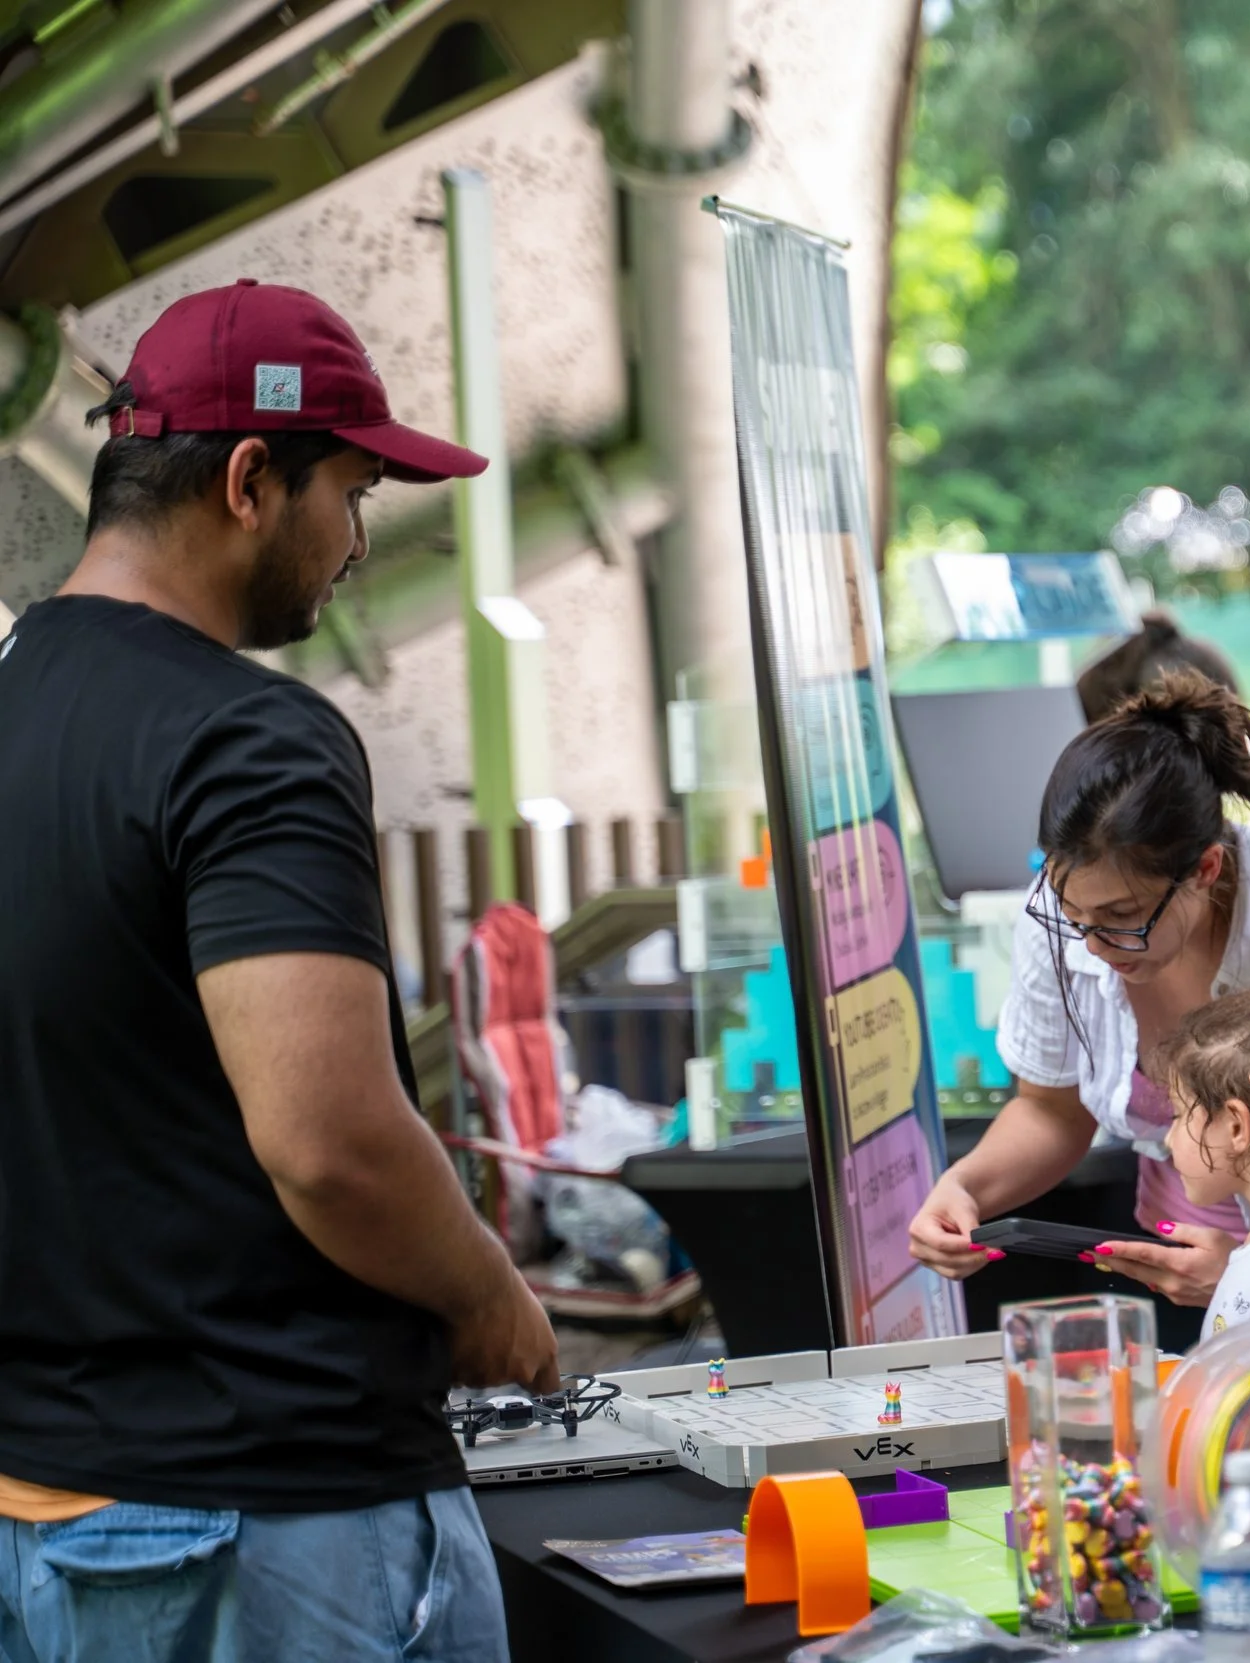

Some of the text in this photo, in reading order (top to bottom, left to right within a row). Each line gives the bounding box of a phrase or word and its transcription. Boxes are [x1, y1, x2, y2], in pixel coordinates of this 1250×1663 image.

[603, 1399, 621, 1424] VEX
[680, 1434, 700, 1460] VEX
[853, 1436, 916, 1461] VEX
